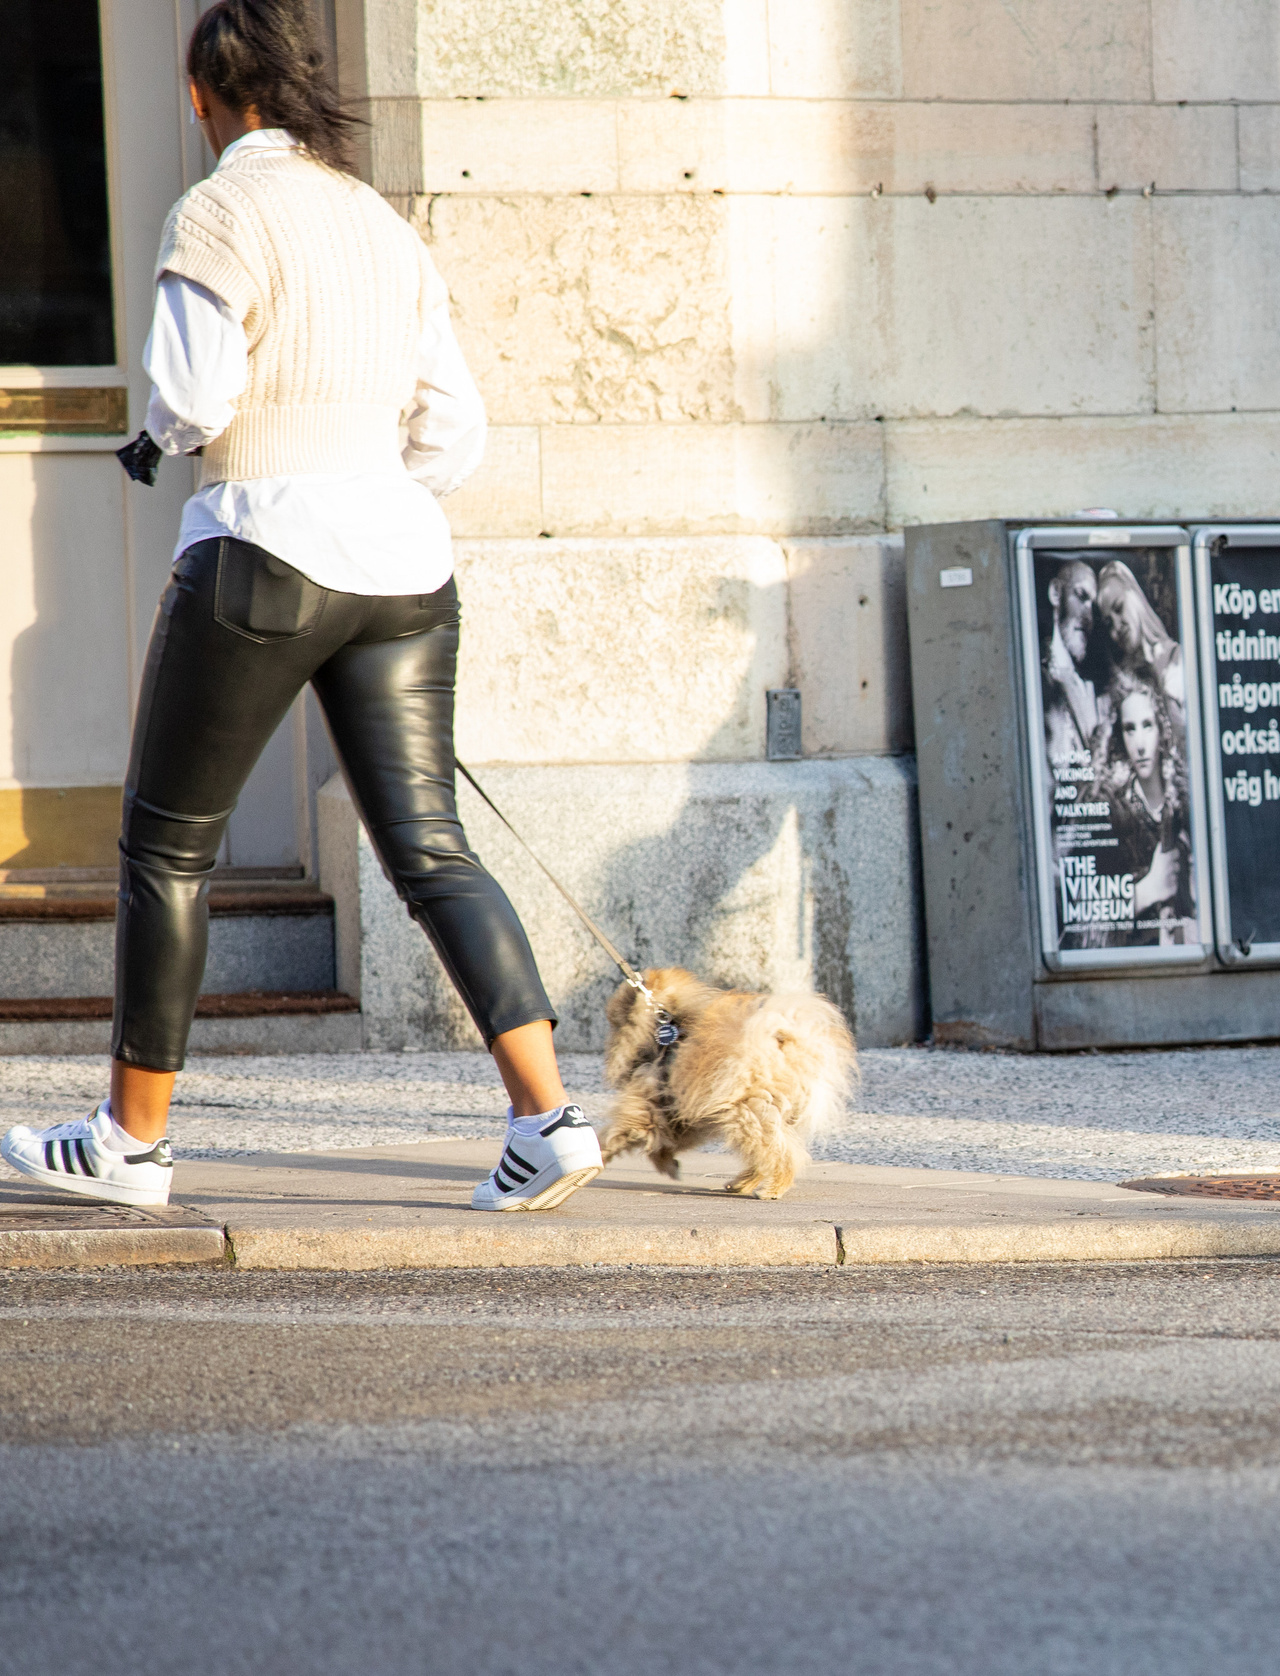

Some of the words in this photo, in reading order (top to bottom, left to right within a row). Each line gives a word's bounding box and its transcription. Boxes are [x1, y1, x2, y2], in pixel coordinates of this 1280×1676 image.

[1214, 583, 1257, 620] Köp
[1222, 718, 1280, 755] också
[1052, 749, 1092, 764] AMONG
[1053, 767, 1095, 782] VIKINGS
[1054, 785, 1077, 800] AND
[1224, 770, 1262, 807] väg
[1055, 801, 1111, 817] VALKYRIES
[1065, 855, 1096, 877] THE
[1065, 873, 1135, 899] VIKING
[1067, 899, 1135, 922] MUSEUM
